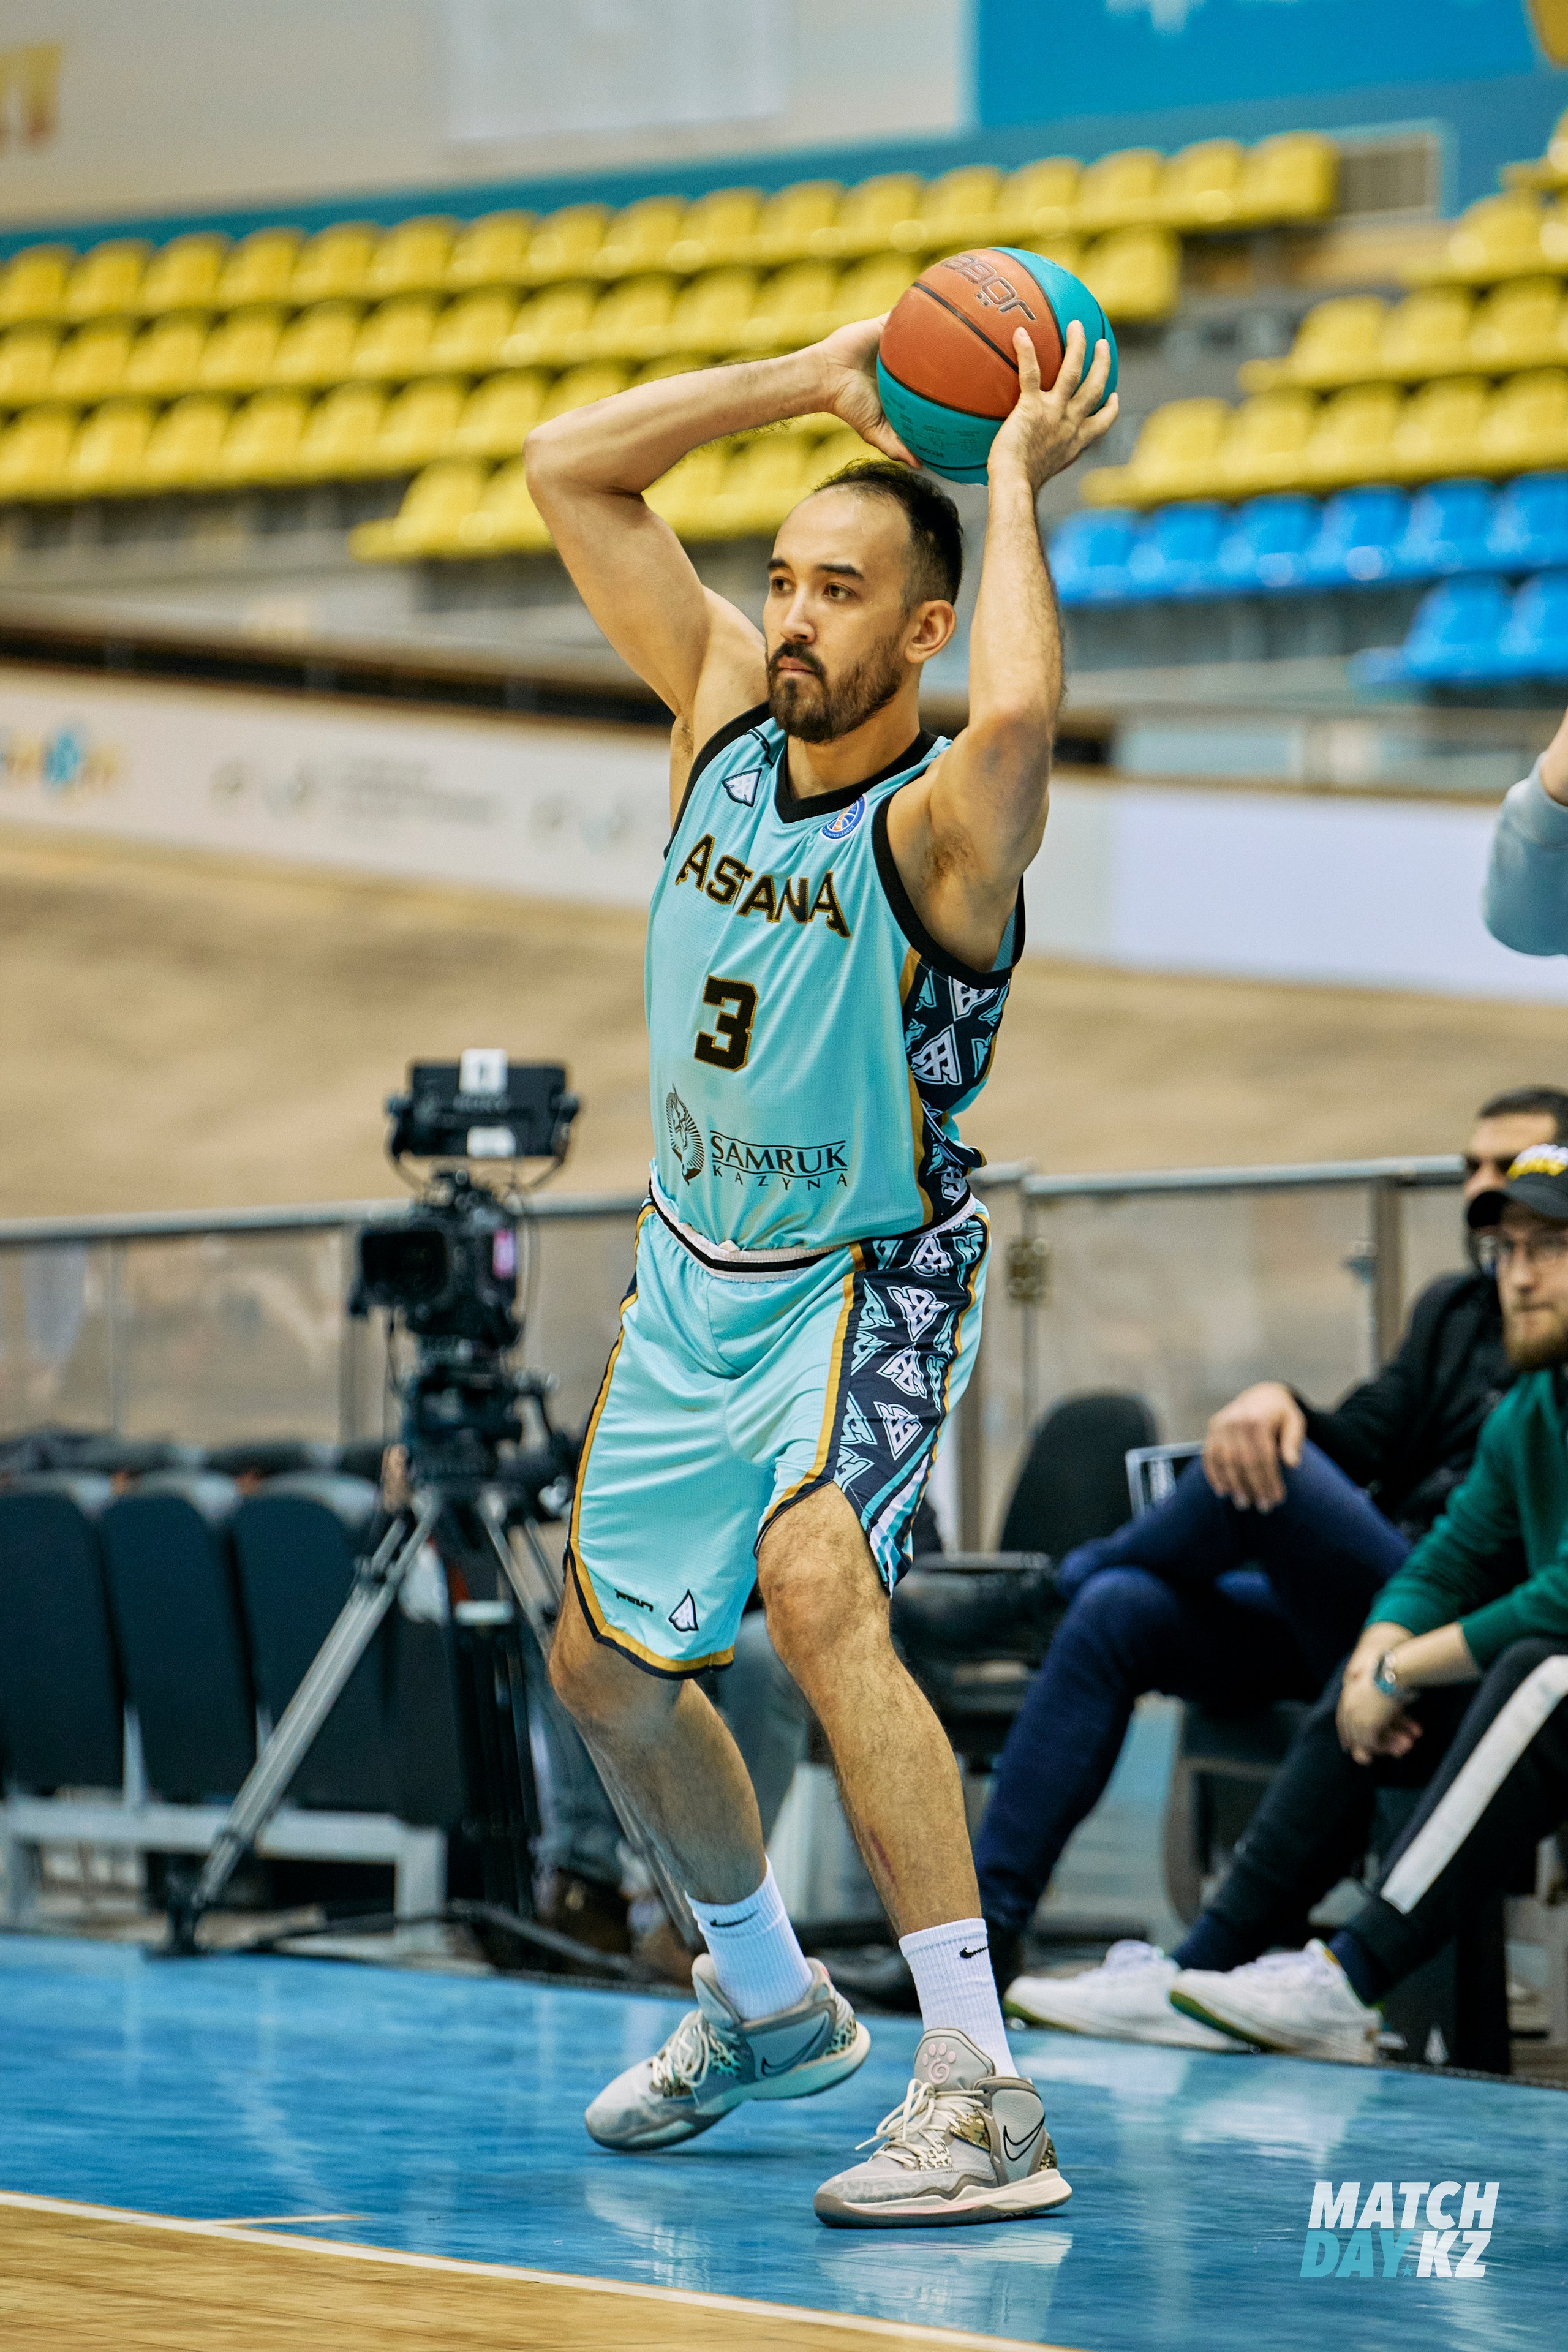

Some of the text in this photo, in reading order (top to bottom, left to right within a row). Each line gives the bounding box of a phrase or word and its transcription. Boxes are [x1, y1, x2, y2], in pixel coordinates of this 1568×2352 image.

[839, 825, 854, 836] LEAGUE
[694, 974, 759, 1072] 3
[710, 1135, 848, 1174] SAMRUK
[712, 1164, 848, 1191] KAZYNA
